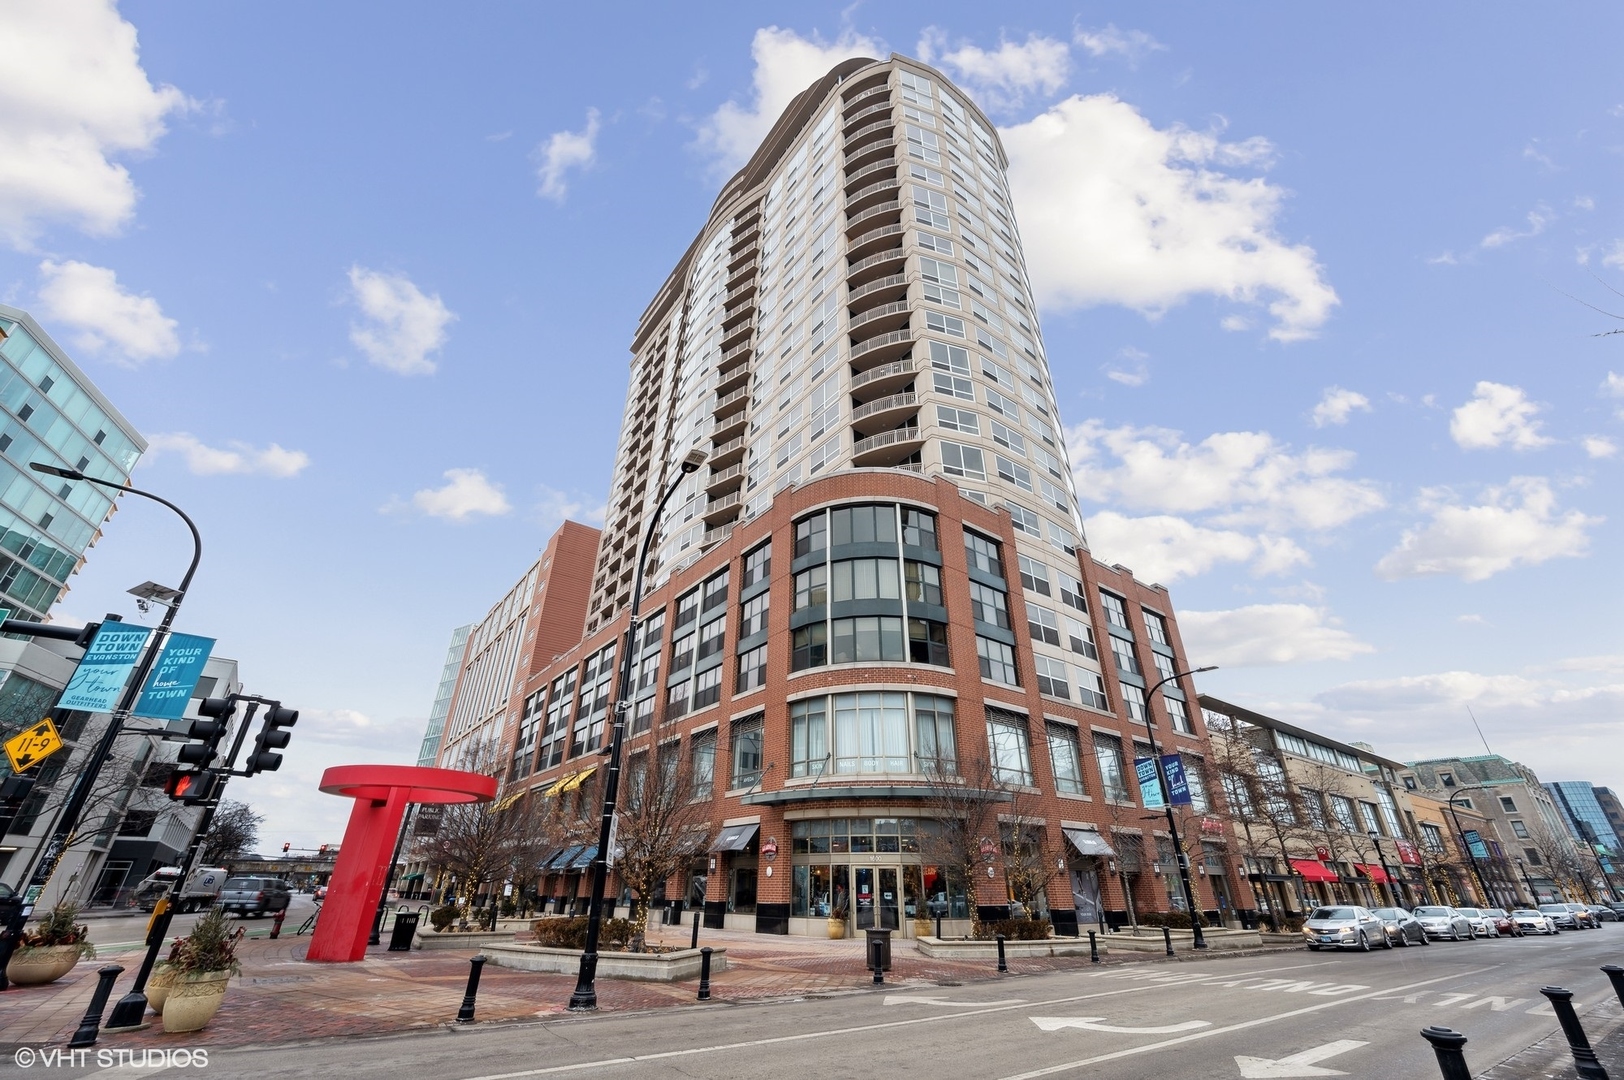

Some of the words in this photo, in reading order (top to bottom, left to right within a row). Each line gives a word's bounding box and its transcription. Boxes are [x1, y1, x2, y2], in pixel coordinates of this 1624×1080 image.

[98, 634, 146, 643] DOWN
[95, 643, 141, 652] TOWN
[86, 653, 138, 661] EVANSTON
[169, 648, 202, 657] YOUR
[163, 656, 196, 665] KIND
[161, 666, 178, 674] OF
[152, 671, 181, 688] home
[71, 694, 108, 704] GEARHEAD
[148, 689, 187, 700] TOWN
[66, 699, 108, 710] OUTFITTERS
[839, 760, 856, 768] NAILS
[1165, 761, 1179, 771] YOUR
[1166, 767, 1179, 776] KIND
[1171, 786, 1187, 796] TOWN
